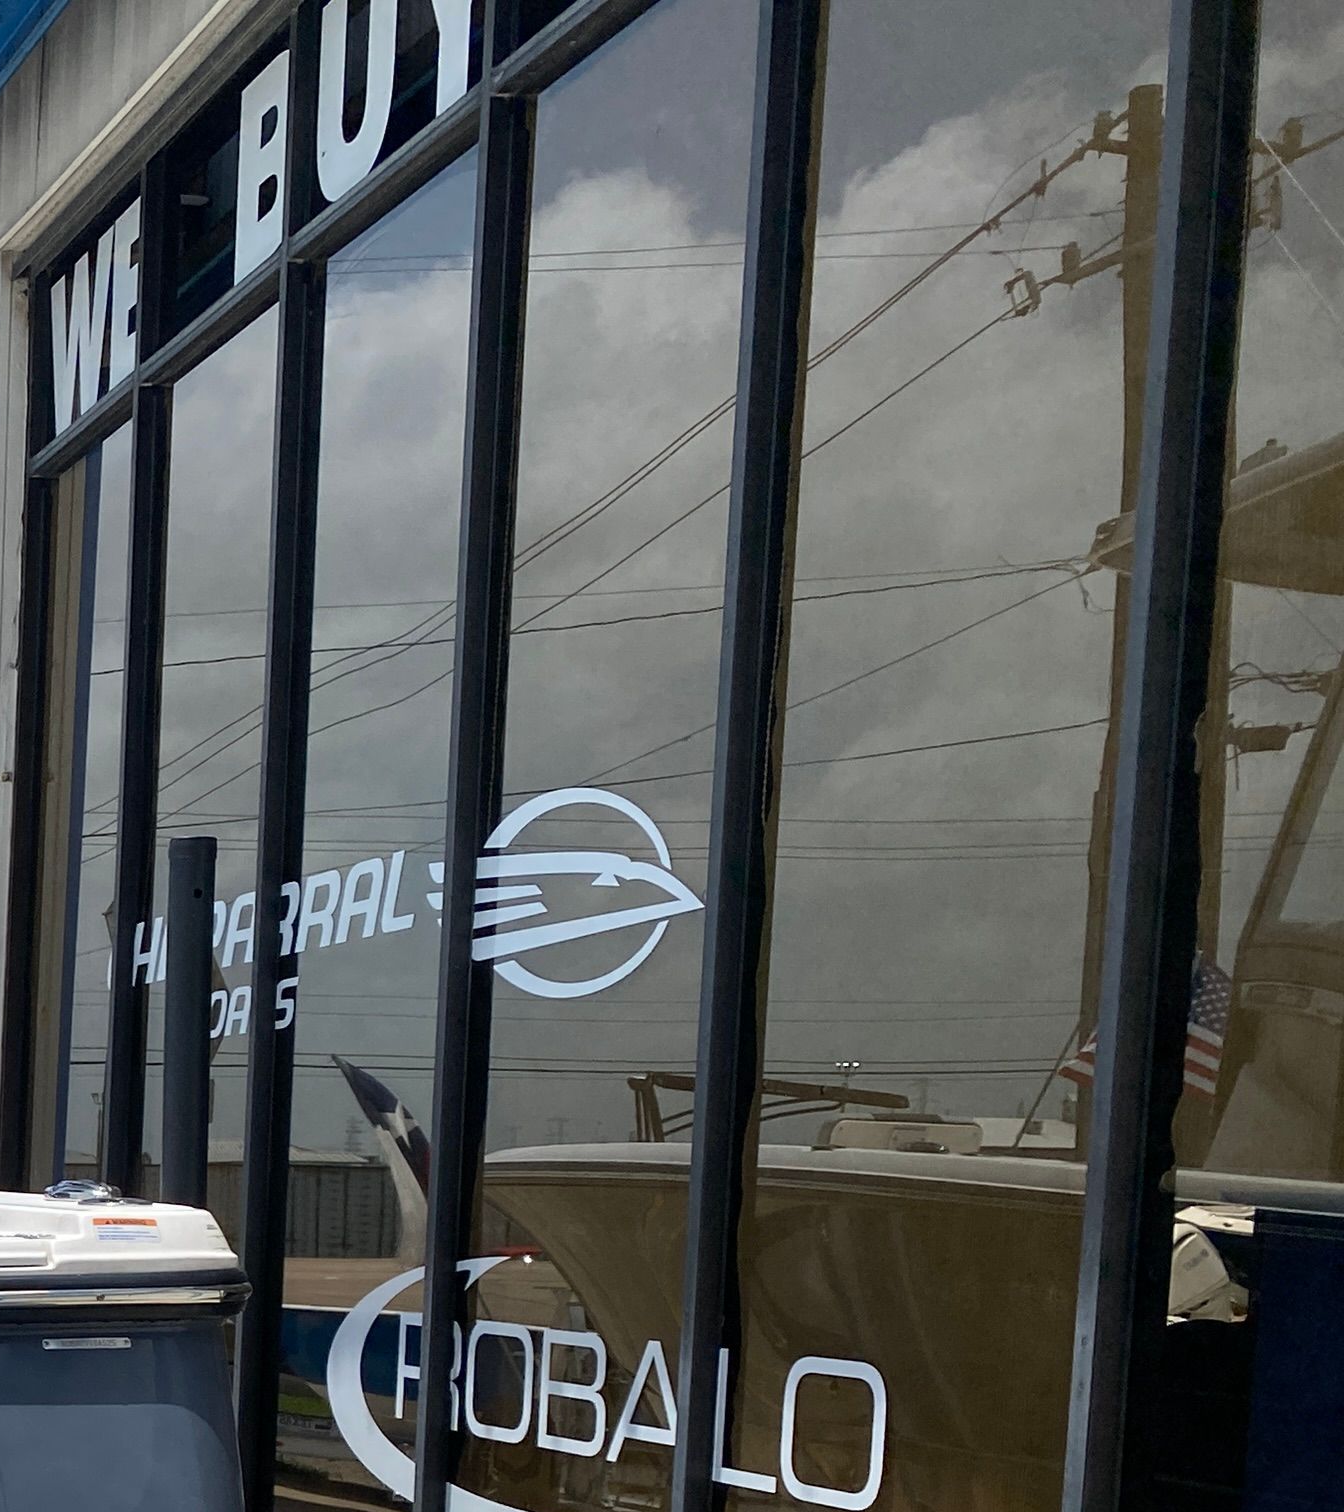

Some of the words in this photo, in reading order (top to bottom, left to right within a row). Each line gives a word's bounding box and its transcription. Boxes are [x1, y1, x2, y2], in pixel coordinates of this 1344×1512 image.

[51, 196, 141, 437] WE
[107, 850, 414, 988] HPARRAL
[208, 976, 299, 1039] OAS
[394, 1312, 887, 1512] ROBALO
